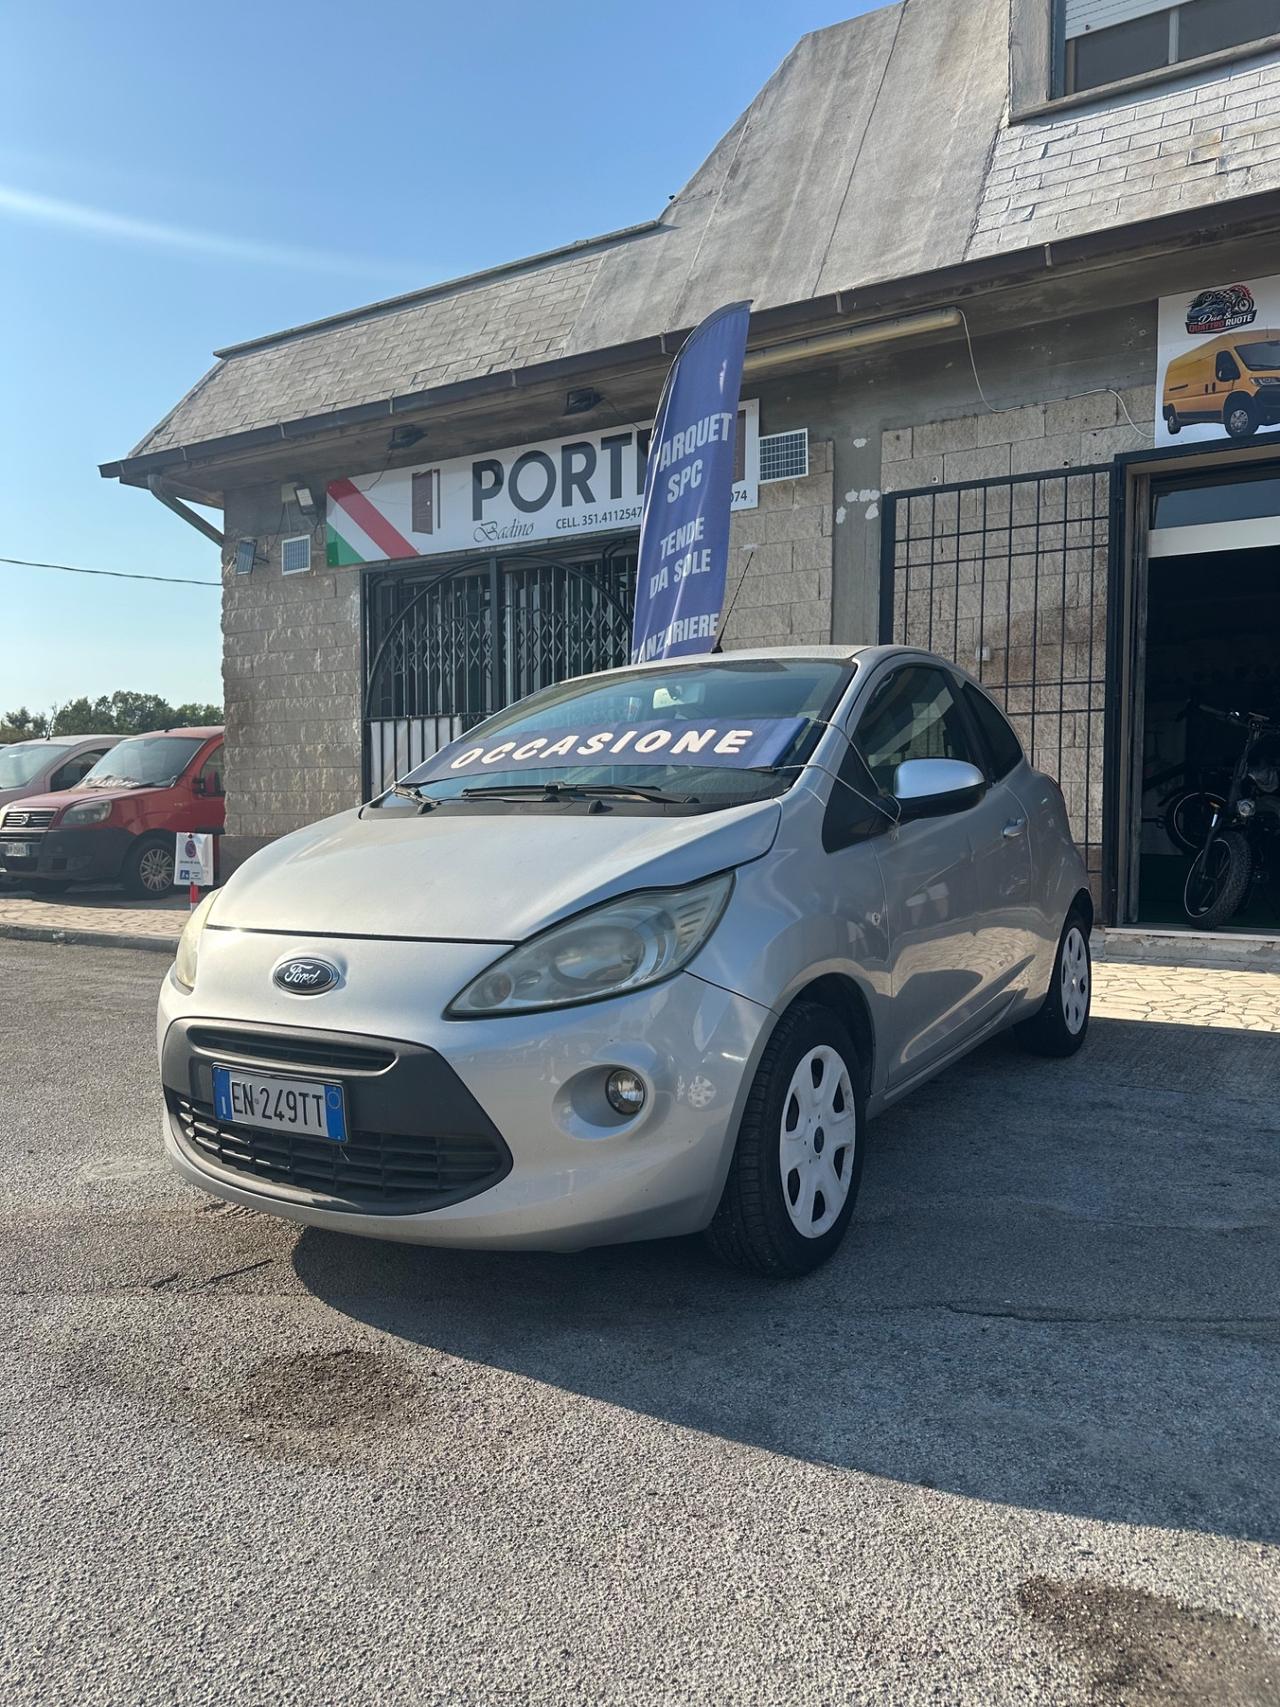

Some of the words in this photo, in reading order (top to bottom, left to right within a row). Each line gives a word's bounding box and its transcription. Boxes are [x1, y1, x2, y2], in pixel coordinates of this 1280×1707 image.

[1225, 313, 1253, 327] RUOTE
[472, 428, 653, 521] PORT
[666, 459, 703, 503] SPC
[473, 518, 534, 543] Badino
[555, 517, 580, 530] CELL.
[660, 517, 705, 560] TENDE
[649, 566, 669, 600] DA
[674, 549, 712, 583] SOLE
[450, 729, 753, 770] OCCASIONE
[284, 963, 321, 984] Ford
